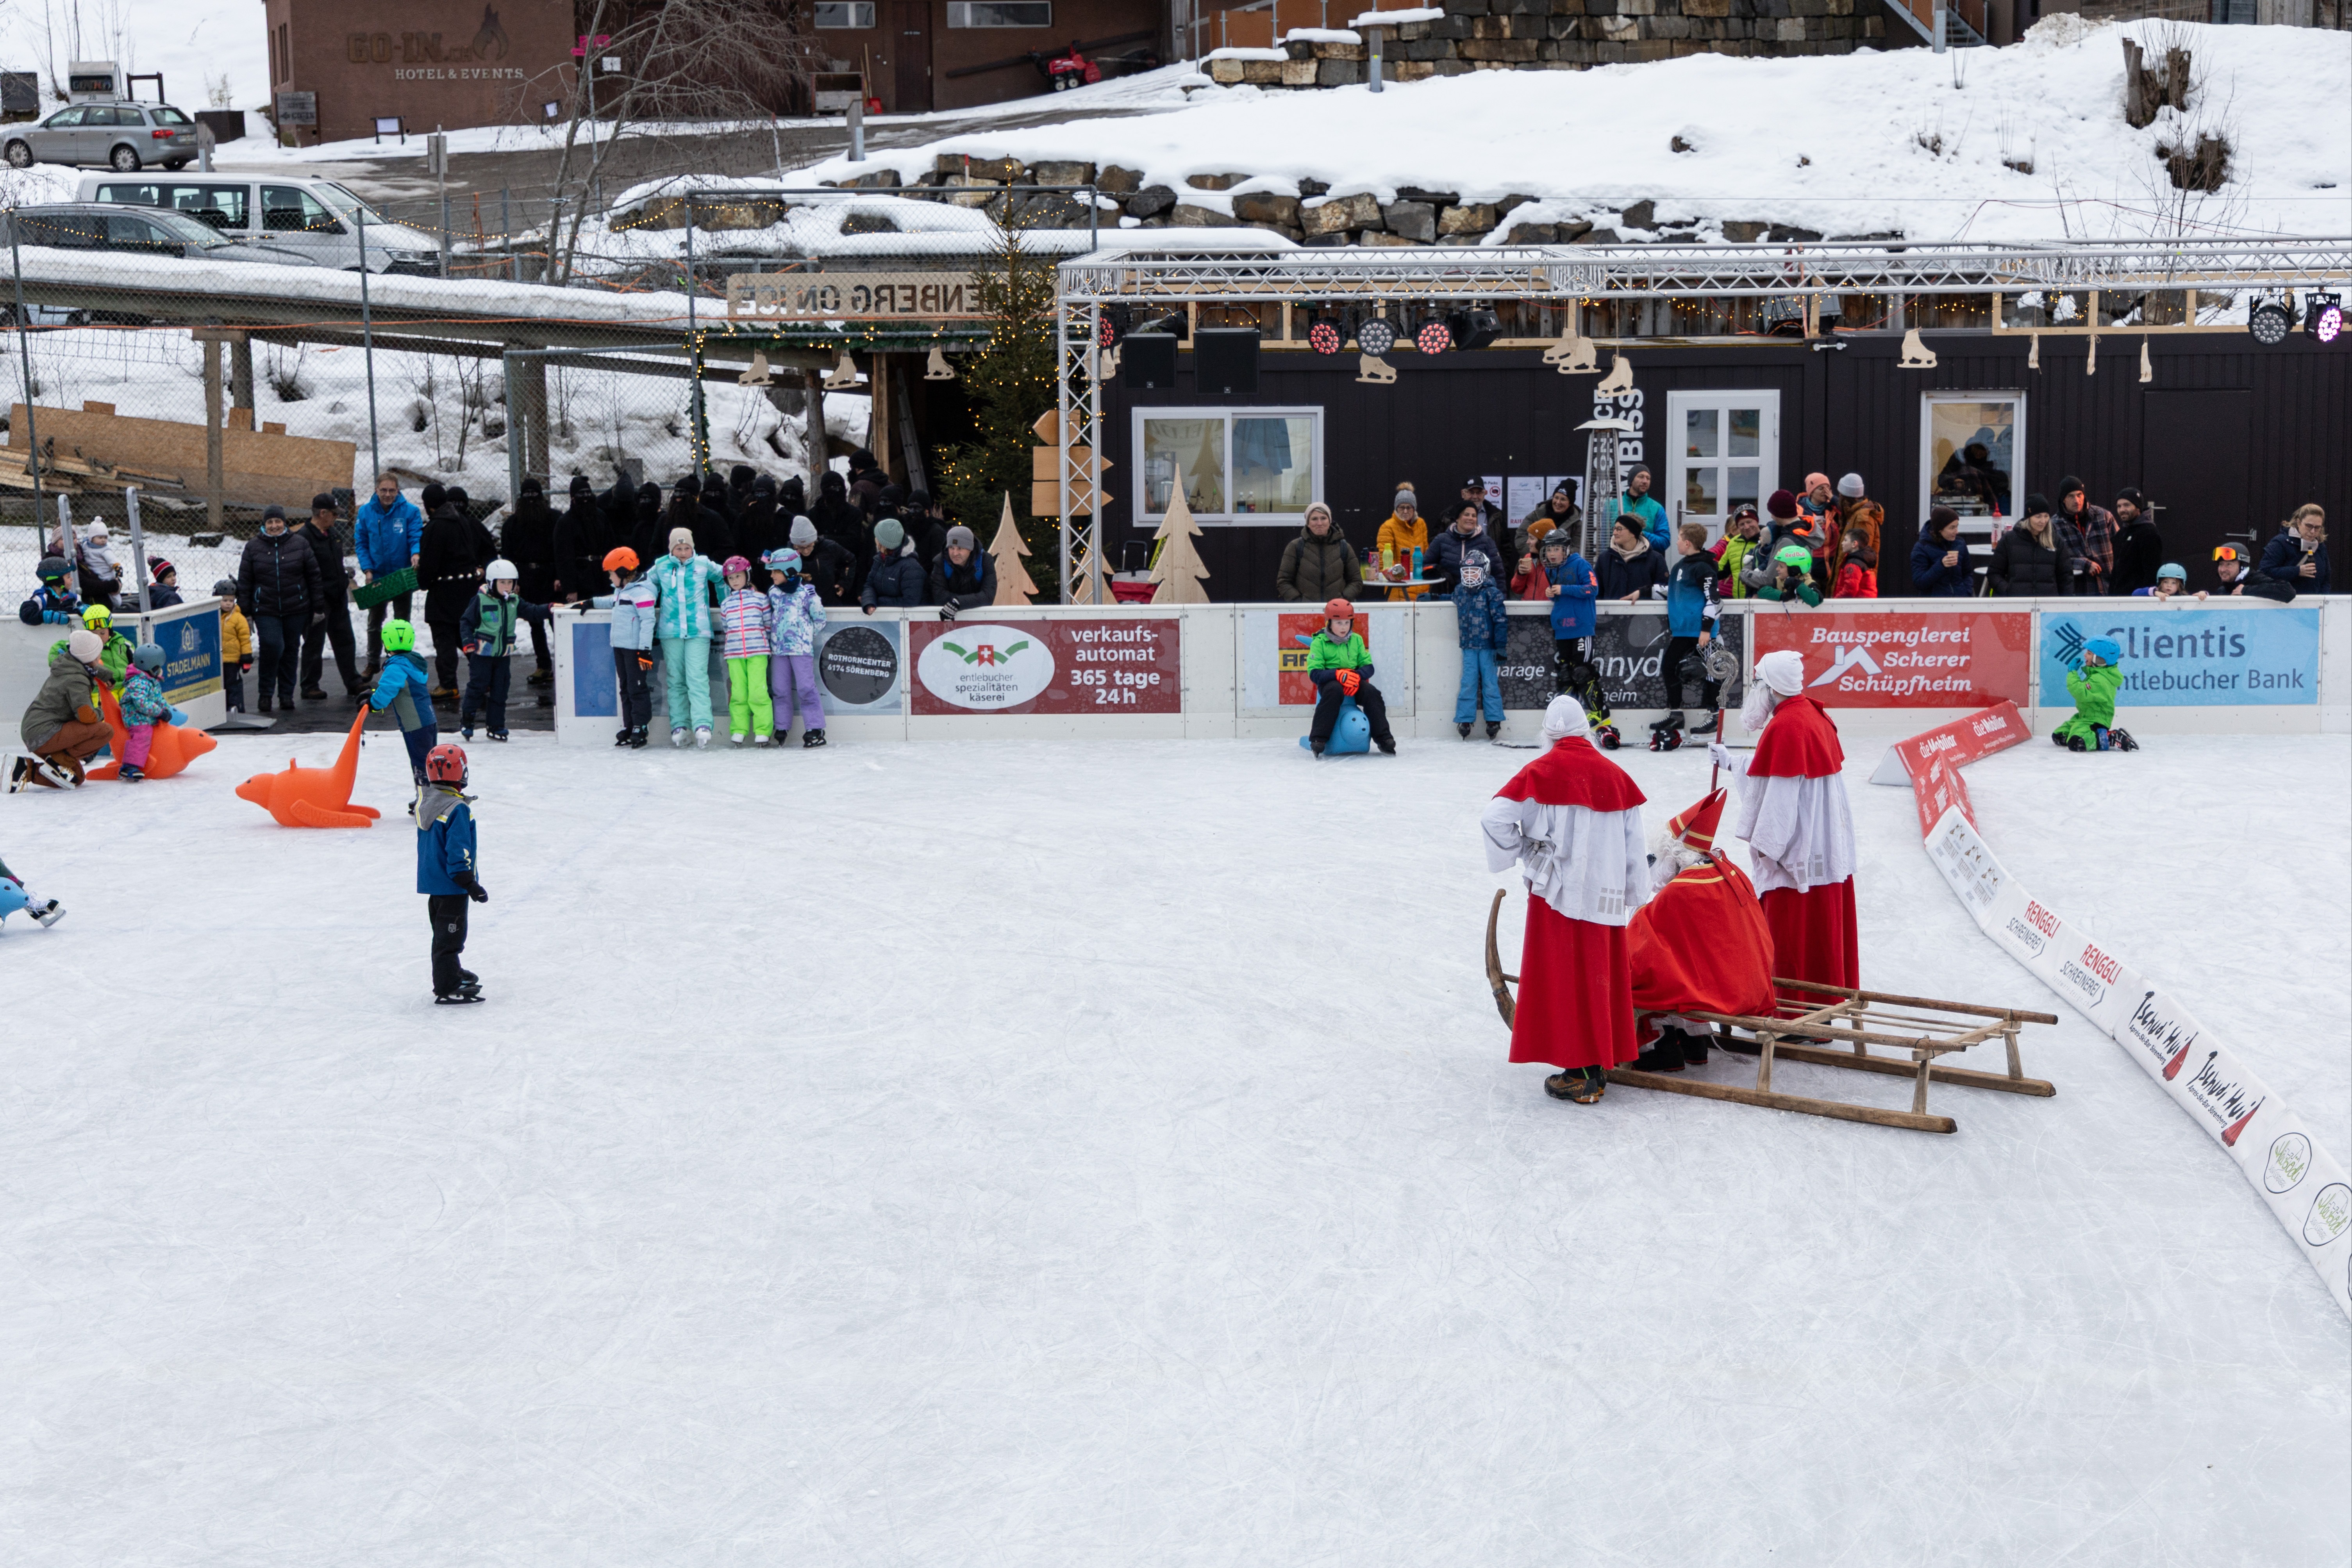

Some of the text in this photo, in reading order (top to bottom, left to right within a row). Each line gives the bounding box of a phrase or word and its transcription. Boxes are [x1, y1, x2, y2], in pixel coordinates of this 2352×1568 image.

[395, 68, 524, 79] HOTEL & EVENTS
[1071, 625, 1159, 643] verkaufs-
[1810, 627, 1970, 647] Bauspenglerei
[828, 654, 891, 668] ROTHORNCENTER
[1076, 646, 1155, 662] automat
[1883, 651, 1970, 667] Scherer
[167, 652, 211, 677] STADELMANN
[827, 664, 890, 678] 6174 SÖRENBERG
[960, 673, 1014, 682] entlebucher
[1071, 670, 1161, 689] 365 tage
[1839, 675, 1972, 696] Schüpfheim
[2116, 668, 2304, 690] ntlebucher Bank
[955, 683, 1018, 694] spezialitäten
[970, 693, 1005, 702] käserei
[1095, 688, 1136, 704] 24 h
[2024, 900, 2061, 939] RENGGLI
[2006, 917, 2043, 951] SCHREINEREI
[2079, 943, 2123, 986] RENGGLI
[2059, 960, 2101, 997] SCHREINEREI
[2149, 1045, 2166, 1065] Sörenberg
[2207, 1105, 2228, 1129] Sörenberg
